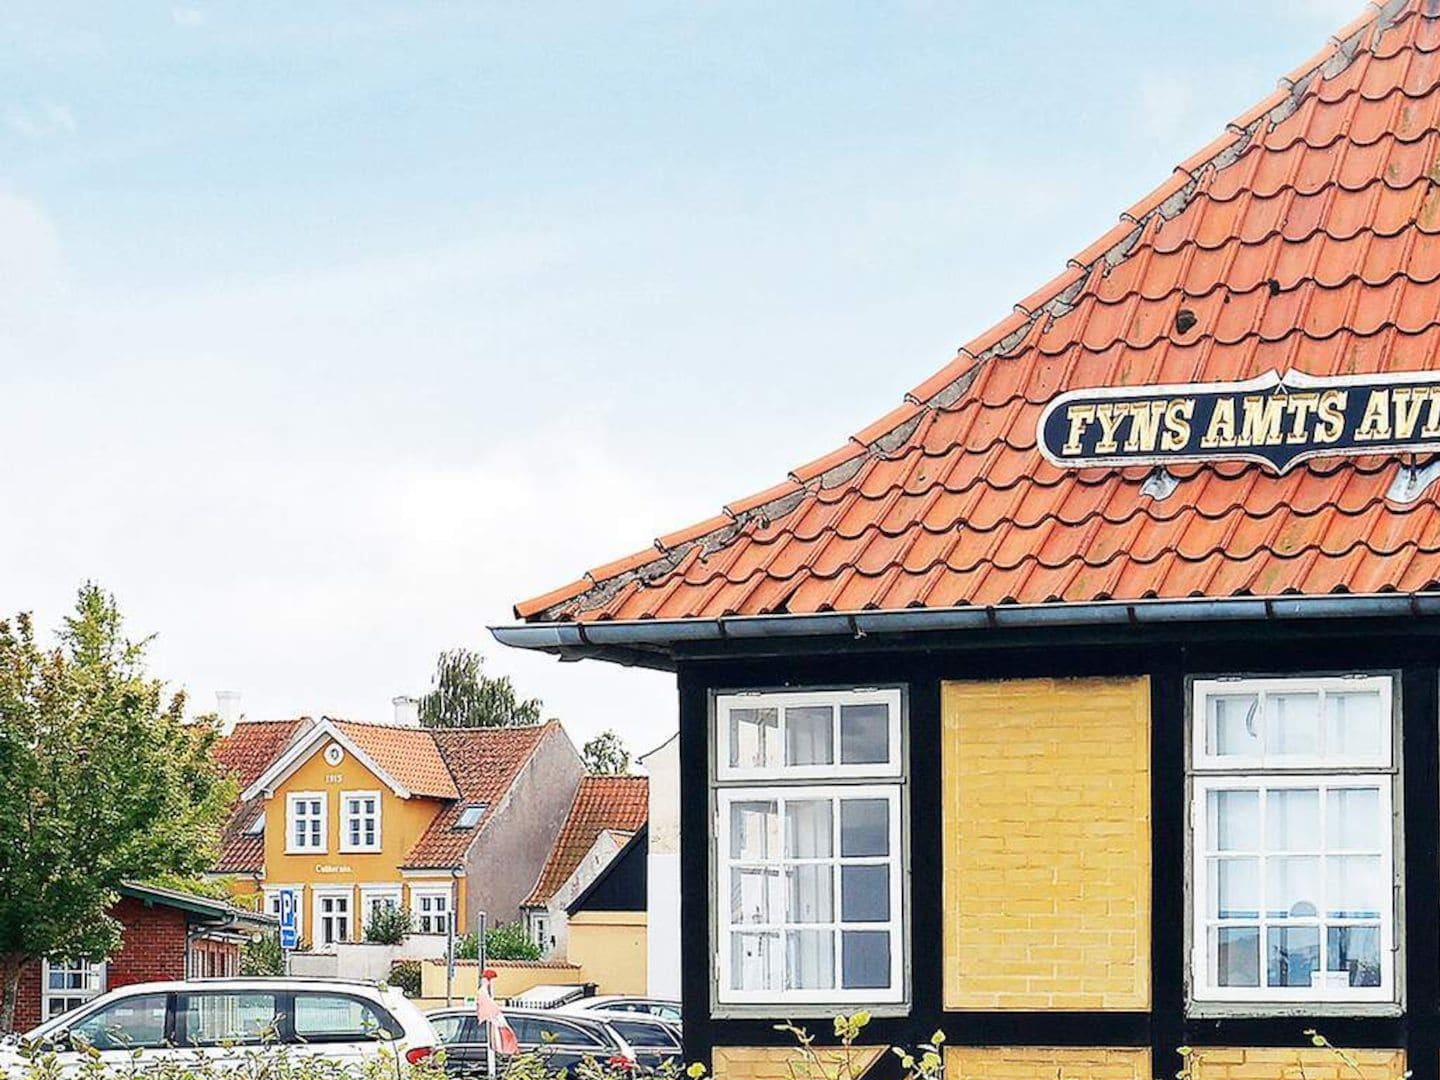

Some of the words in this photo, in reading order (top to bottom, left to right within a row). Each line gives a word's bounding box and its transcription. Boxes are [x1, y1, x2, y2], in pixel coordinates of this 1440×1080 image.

[1062, 398, 1196, 456] FYNS
[1200, 389, 1349, 449] AMTS
[283, 892, 292, 924] P
